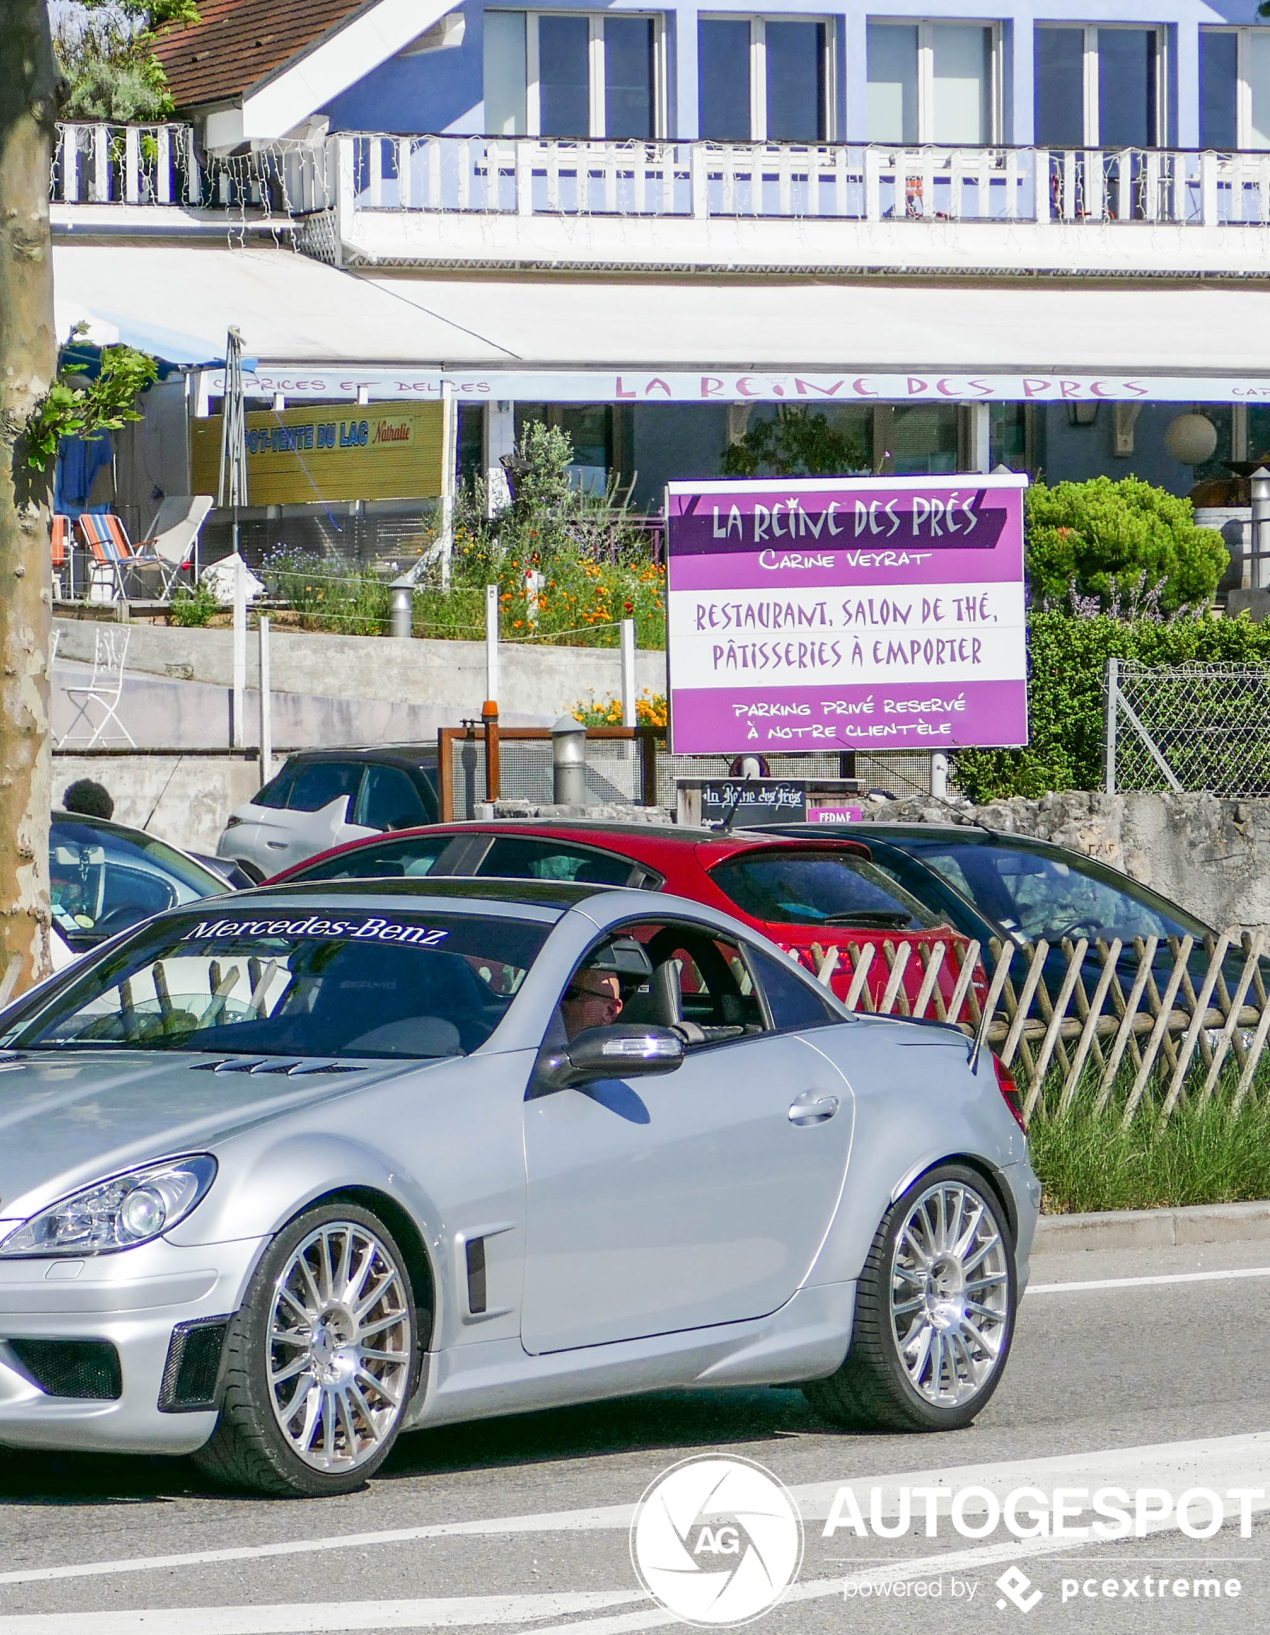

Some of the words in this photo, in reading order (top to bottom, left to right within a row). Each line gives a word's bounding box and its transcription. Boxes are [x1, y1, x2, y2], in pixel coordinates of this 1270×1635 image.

[615, 376, 672, 398] LA
[701, 376, 879, 398] REINE
[907, 377, 995, 397] DES
[317, 422, 336, 449] DU
[340, 420, 369, 447] LAC
[713, 504, 743, 541] LA
[754, 498, 845, 542] REINE
[855, 498, 901, 537] DES
[913, 492, 978, 536] PRÉS
[847, 549, 932, 567] VEYRAT
[696, 601, 833, 630] RESTAURANT,
[842, 598, 912, 626] SALON
[922, 597, 946, 624] DE
[952, 592, 998, 623] THÉ,
[713, 639, 842, 670] PÂTISSERIES
[852, 635, 863, 667] À
[873, 637, 982, 665] EMPORTER
[732, 702, 811, 717] PARKING
[821, 695, 875, 714] PRIVÉ
[884, 692, 966, 714] RESERVÉ
[747, 721, 758, 740] À
[767, 724, 836, 739] NOTRE
[846, 718, 951, 737] CLIENTÈLE
[180, 915, 448, 945] Mercedes-Benz
